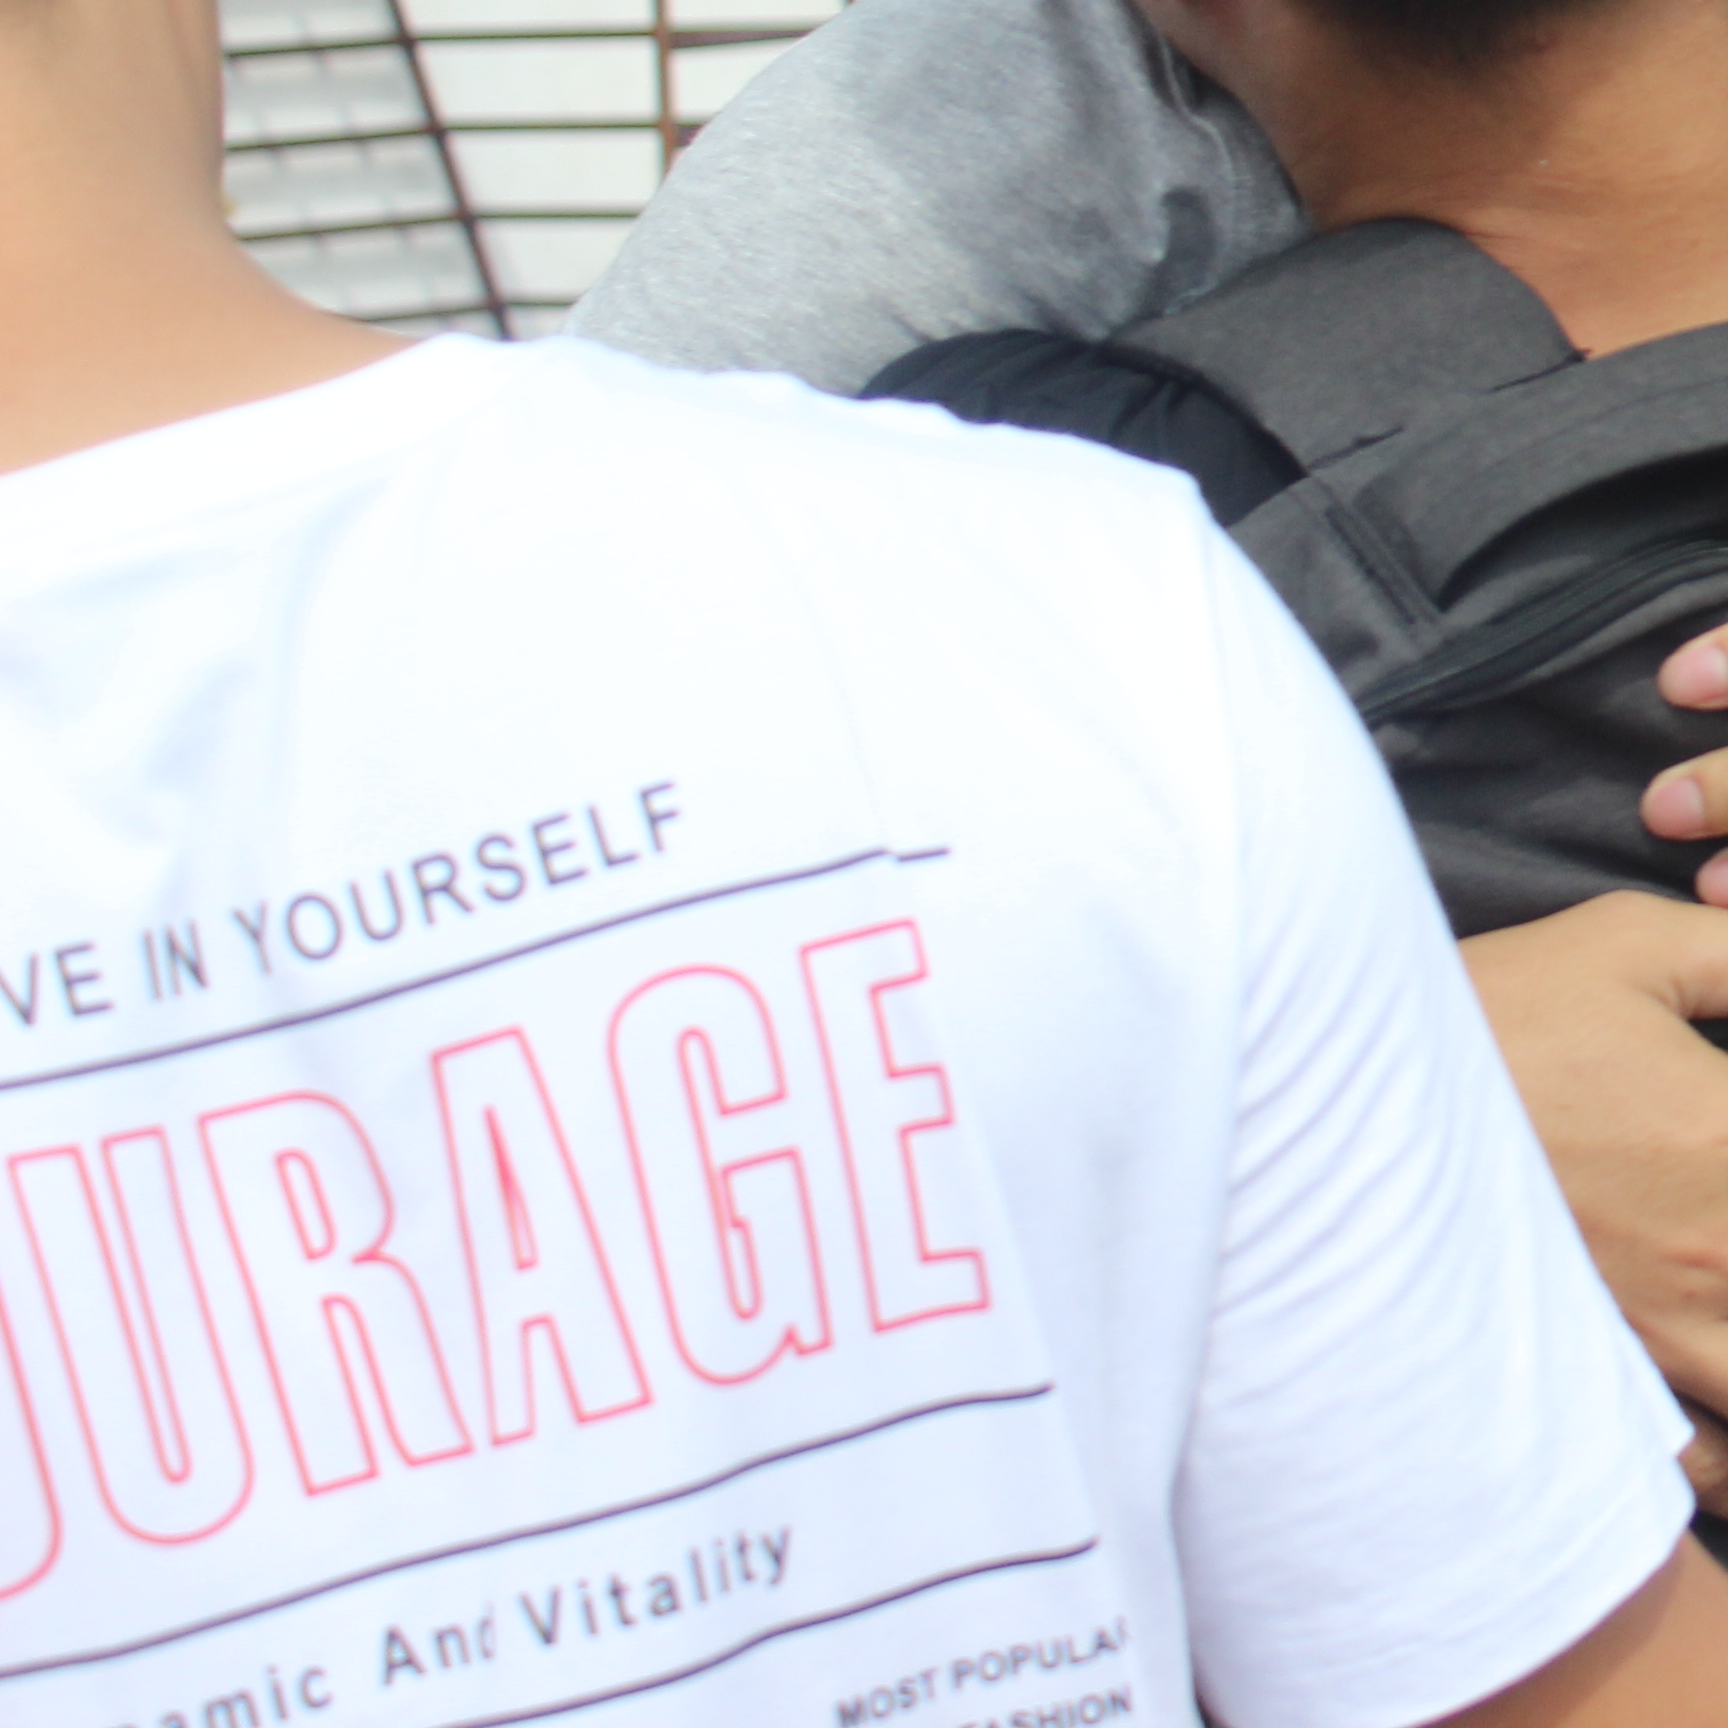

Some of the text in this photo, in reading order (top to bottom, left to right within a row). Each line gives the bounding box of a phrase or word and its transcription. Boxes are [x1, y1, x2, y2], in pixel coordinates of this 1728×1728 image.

[143, 918, 210, 1001] IN
[231, 782, 681, 975] YOURSELF
[518, 1525, 791, 1648] Vitality
[834, 1666, 938, 1728] MOST
